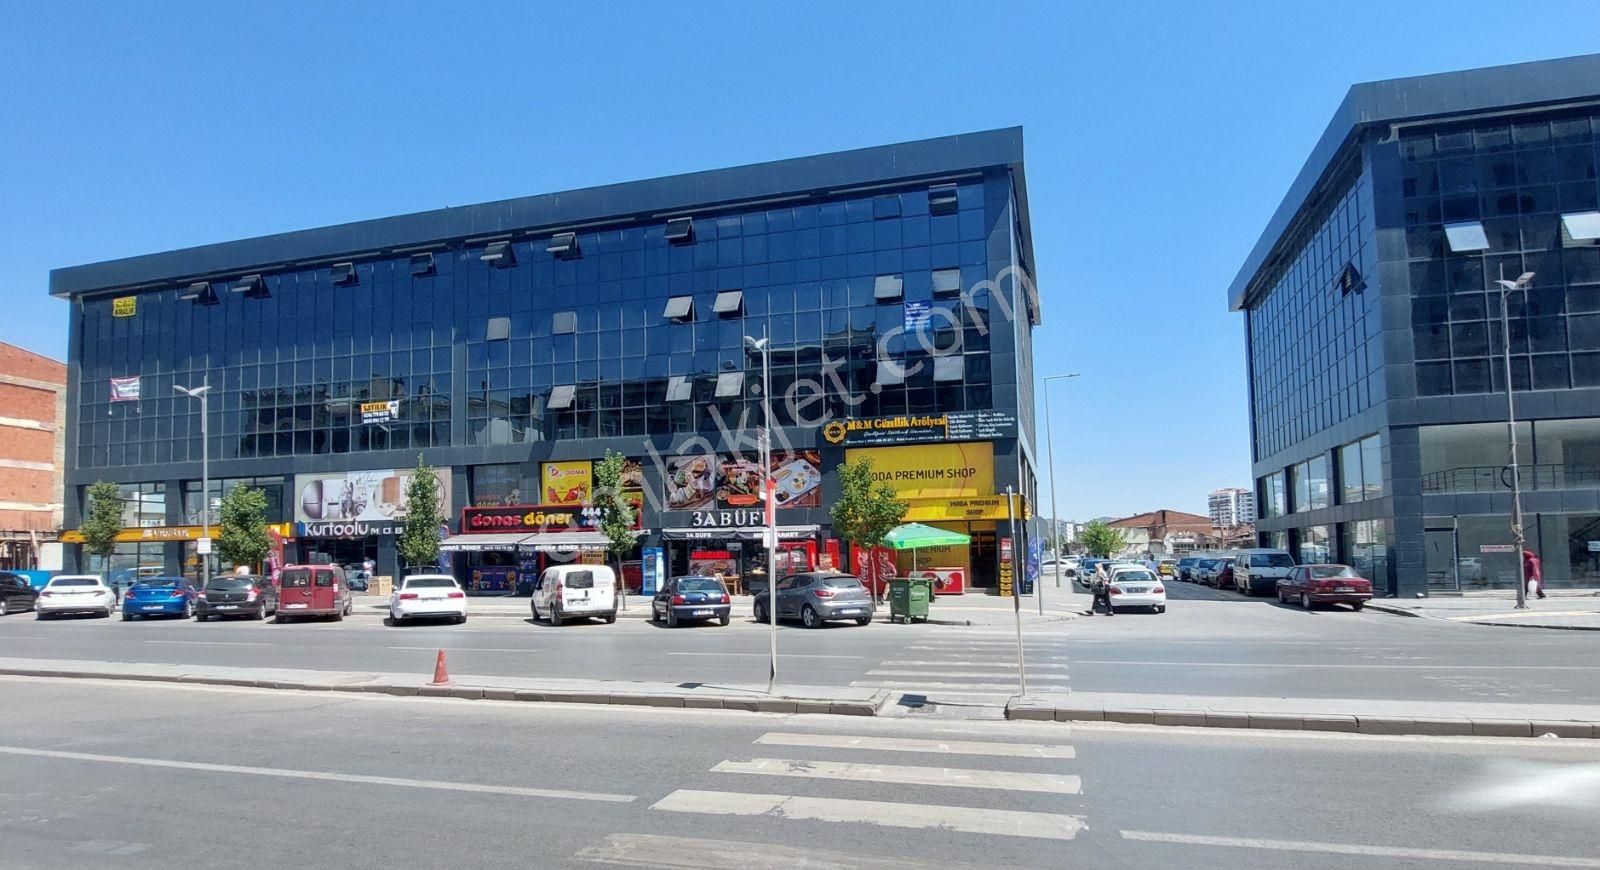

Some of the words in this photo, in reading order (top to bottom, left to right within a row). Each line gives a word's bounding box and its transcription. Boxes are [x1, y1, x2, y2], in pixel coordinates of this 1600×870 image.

[363, 403, 387, 411] SATILIK
[847, 420, 872, 430] M&M
[874, 416, 909, 429] Güzellik
[871, 472, 893, 482] ODA
[895, 470, 944, 481] PREMIUM
[947, 468, 976, 478] SHOP
[581, 507, 601, 516] 444
[692, 511, 717, 527] 3A
[720, 509, 767, 526] BÜF
[471, 513, 521, 527] donas
[523, 511, 573, 527] döner
